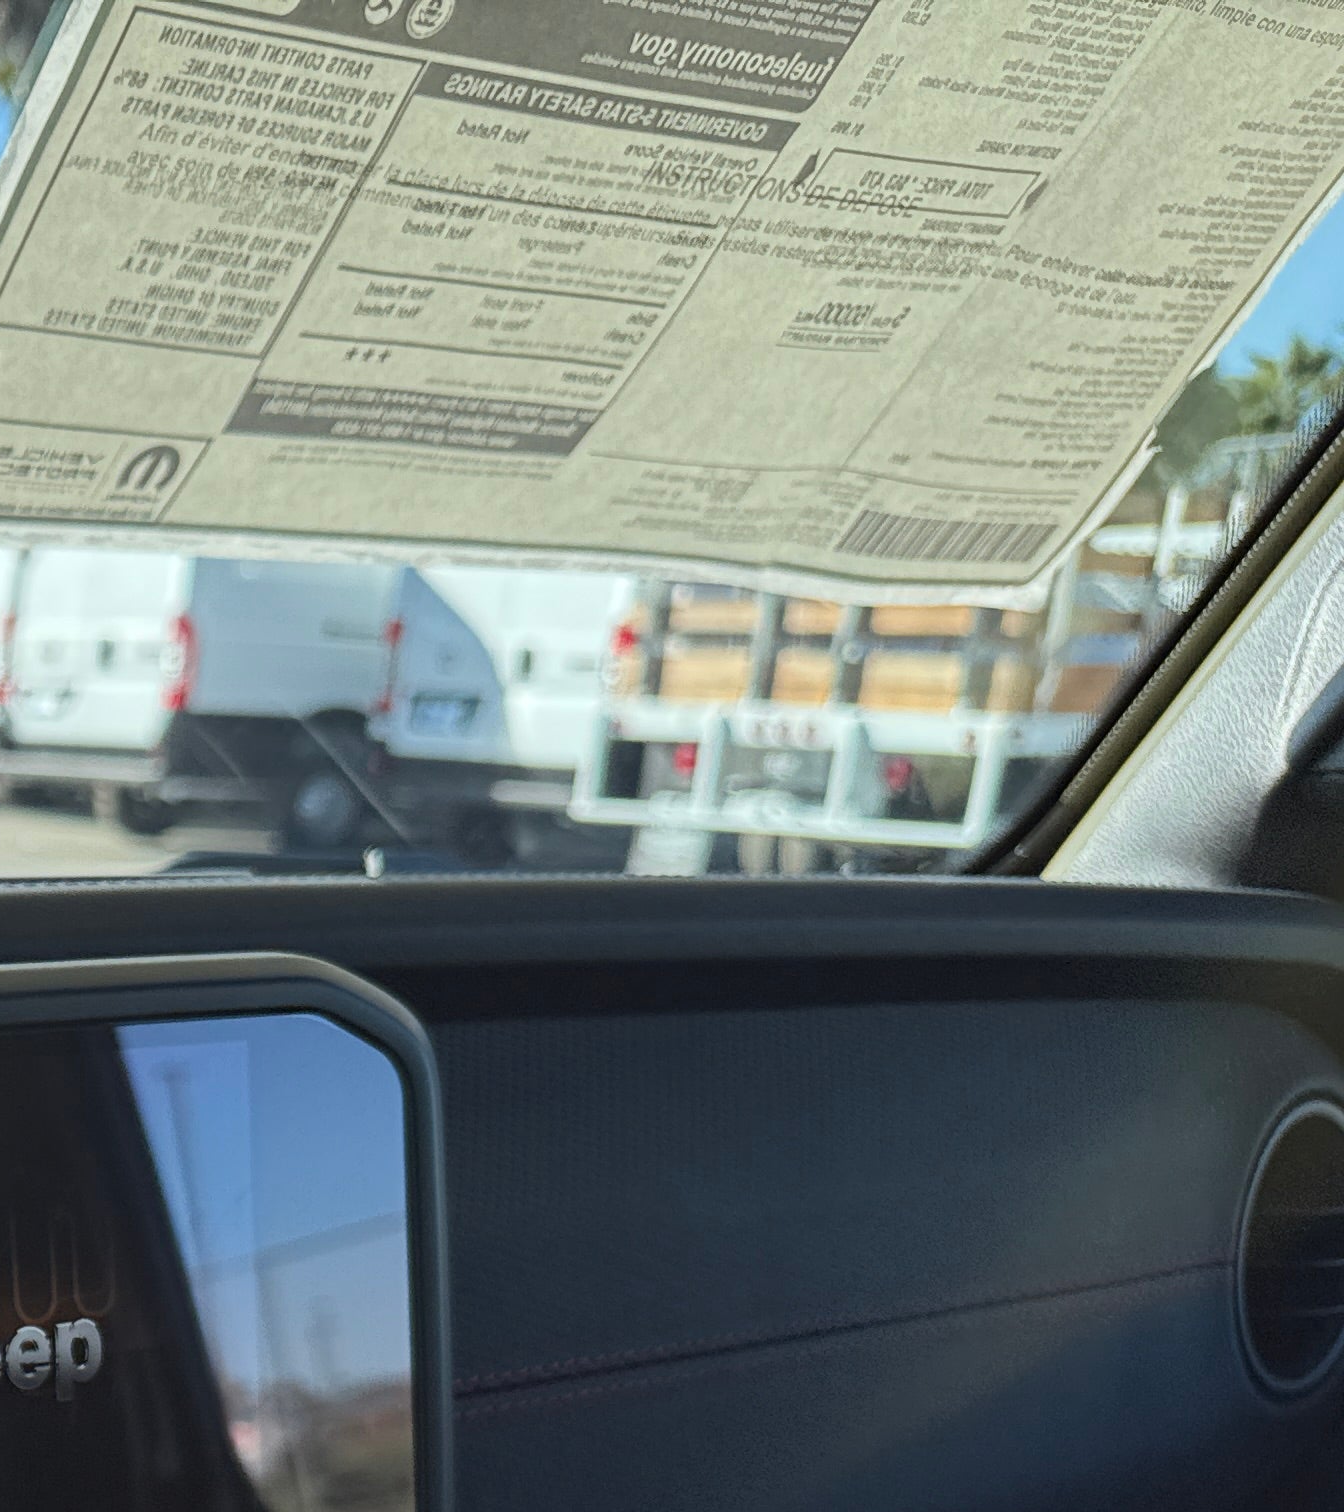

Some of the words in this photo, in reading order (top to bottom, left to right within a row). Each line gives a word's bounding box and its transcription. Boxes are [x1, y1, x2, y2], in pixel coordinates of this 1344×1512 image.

[1210, 1, 1257, 27] limpie
[1257, 16, 1286, 35] con
[1285, 23, 1312, 42] una
[138, 121, 180, 145] Afin
[643, 161, 806, 205] INSTRUCTIONS
